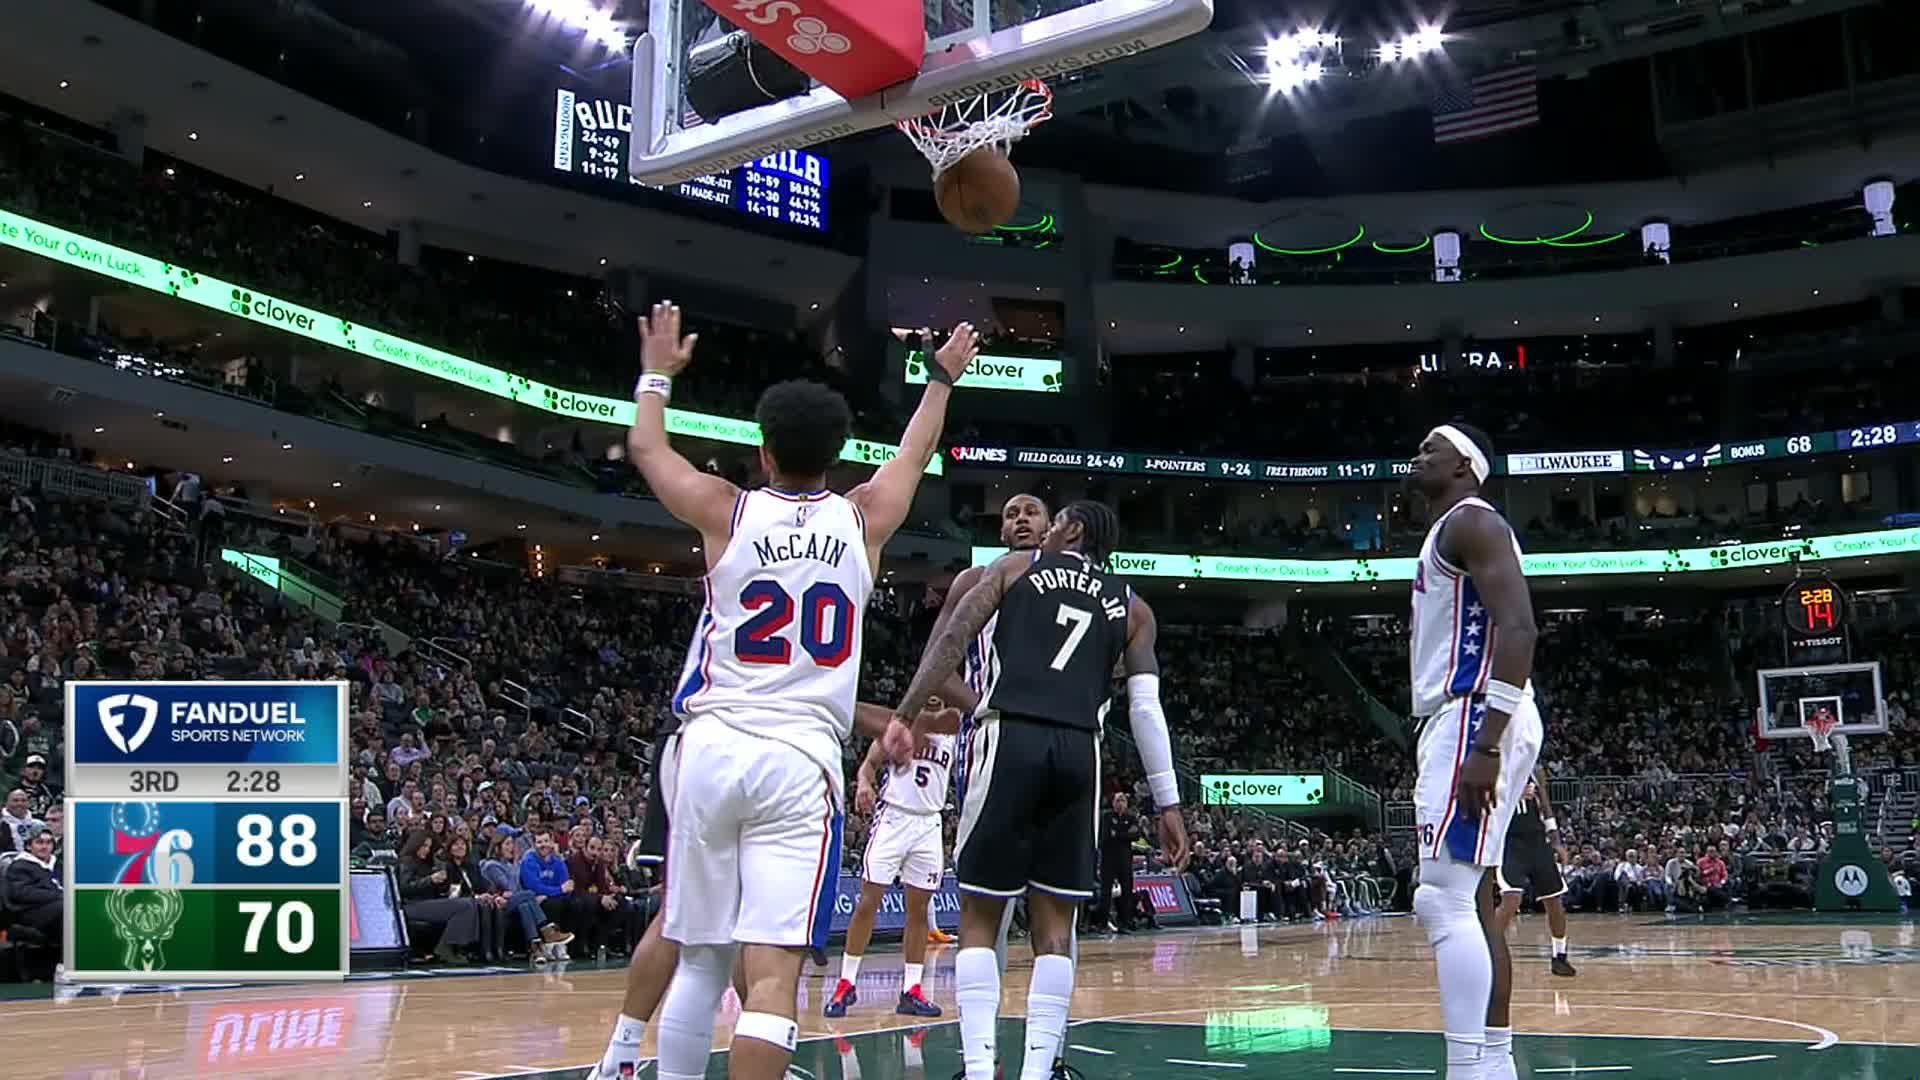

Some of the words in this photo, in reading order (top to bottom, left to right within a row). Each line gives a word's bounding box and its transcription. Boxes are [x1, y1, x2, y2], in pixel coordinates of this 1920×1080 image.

[582, 130, 620, 149] 24-49
[589, 147, 618, 165] 9-24
[582, 161, 618, 180] 11-17
[746, 170, 780, 188] 30-59
[747, 185, 780, 203] 14-30
[24, 226, 60, 252] Your
[65, 241, 103, 265] Own
[107, 255, 146, 279] Luck.
[254, 299, 315, 331] clover
[373, 339, 411, 361] Create
[414, 351, 438, 368] Your
[440, 359, 466, 378] Own
[964, 358, 1024, 378] clover
[560, 394, 616, 418] clover
[672, 416, 709, 433] Create
[712, 423, 737, 436] Your
[1786, 435, 1812, 454] 68
[1851, 425, 1897, 447] 2:28
[1018, 451, 1047, 463] FIELD
[1049, 453, 1082, 465] GOALS
[1086, 454, 1125, 469] 24-49
[1731, 443, 1766, 459] BONUS
[1144, 458, 1206, 473] 3-POINTERS
[1221, 462, 1251, 476] 9-24
[1266, 465, 1289, 477] FREE
[1289, 466, 1329, 477] THROWS
[1337, 463, 1376, 477] 11-17
[753, 533, 848, 568] McCAIN
[1731, 546, 1787, 562] clover
[1279, 565, 1304, 576] Own
[1589, 558, 1617, 569] Own
[1028, 567, 1103, 598] PORTER
[1101, 596, 1127, 622] JR
[734, 579, 856, 669] 20
[1807, 603, 1833, 629] 14
[1050, 603, 1094, 672] 7
[1806, 637, 1842, 647] TISSOT
[914, 766, 930, 788] 5
[1232, 780, 1283, 796] clover
